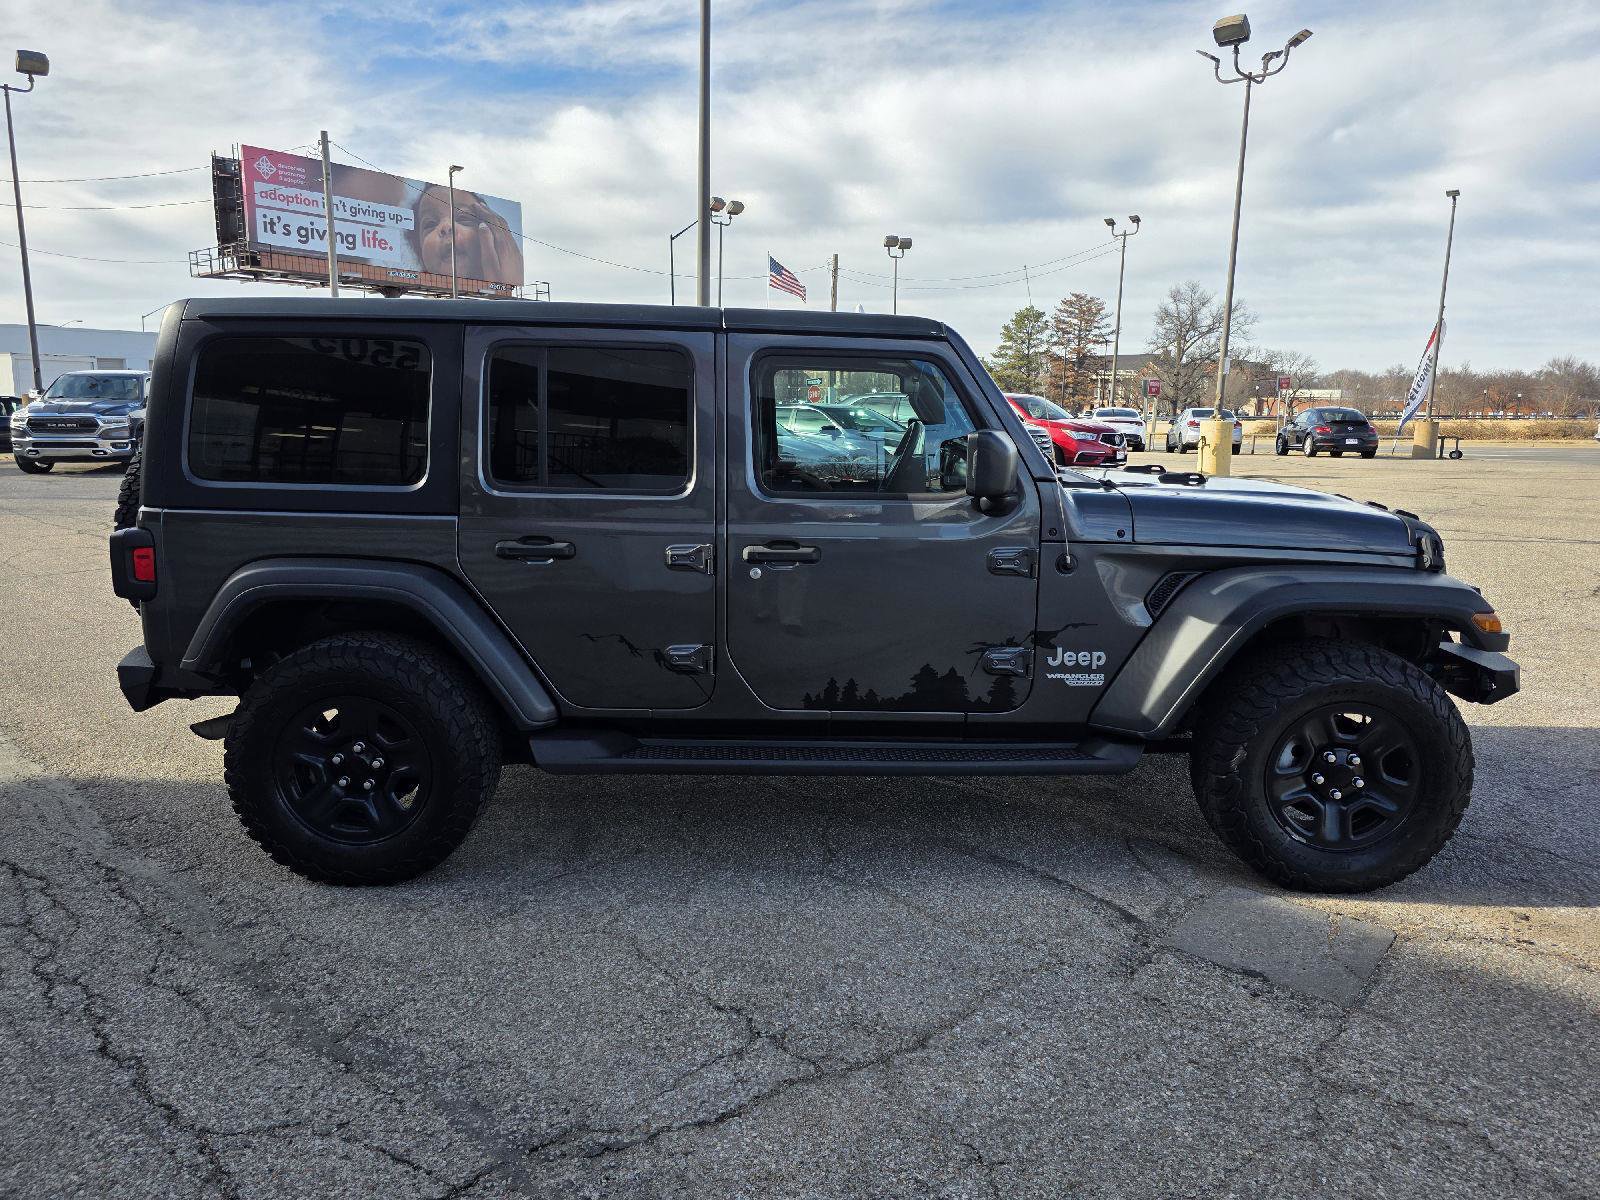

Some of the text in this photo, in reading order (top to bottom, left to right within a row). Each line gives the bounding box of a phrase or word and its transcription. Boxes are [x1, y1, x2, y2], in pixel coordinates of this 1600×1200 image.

[259, 190, 319, 208] adoption
[322, 197, 347, 213] in't
[349, 204, 385, 222] giving
[262, 214, 393, 252] it's givng life.
[1046, 646, 1107, 669] Jeep
